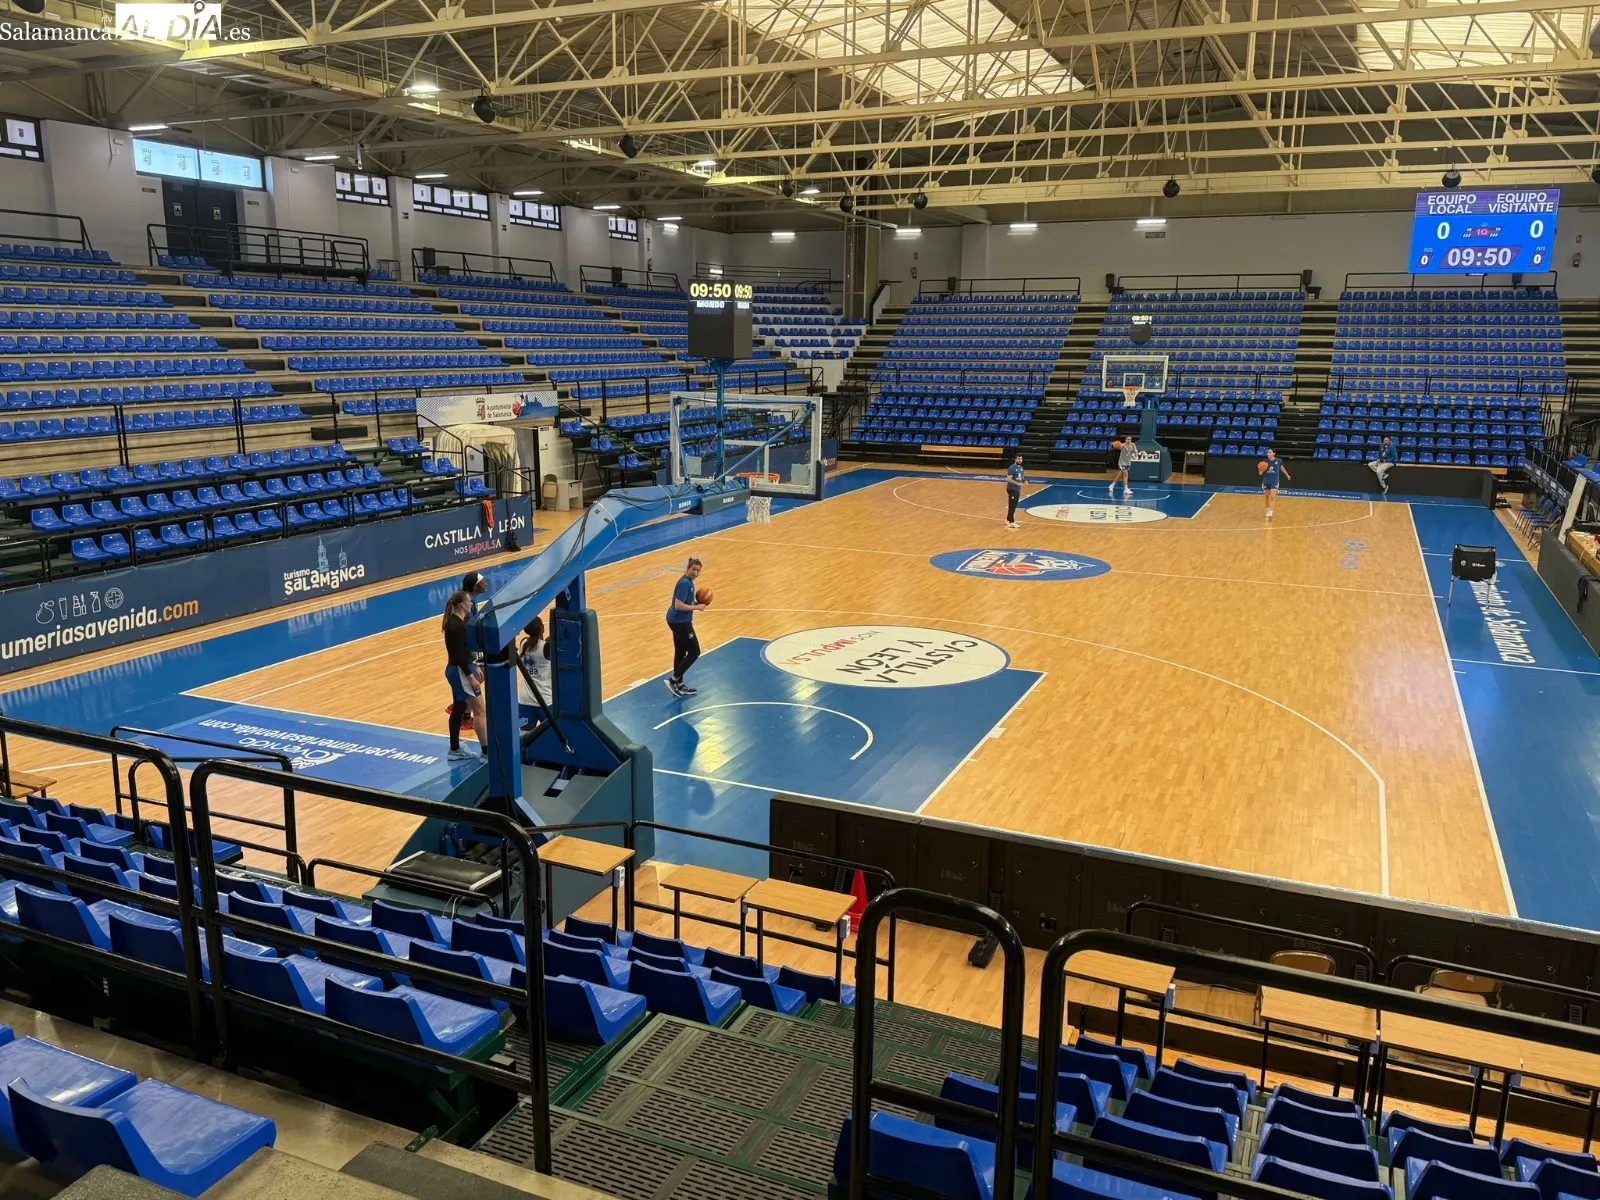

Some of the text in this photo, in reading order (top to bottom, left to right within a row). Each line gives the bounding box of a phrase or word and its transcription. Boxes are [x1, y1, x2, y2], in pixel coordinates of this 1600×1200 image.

[1427, 194, 1477, 205] EQUIPO
[1496, 192, 1547, 203] EQUIPO
[1429, 204, 1473, 215] LOCAL
[1488, 202, 1554, 213] VISITANTE
[1437, 221, 1450, 239] 0
[1477, 228, 1488, 236] 1Q
[1530, 220, 1544, 238] 0
[1420, 255, 1428, 265] 0
[1447, 247, 1512, 266] 09:50
[1533, 253, 1541, 264] 0
[690, 283, 732, 298] 09:50
[424, 525, 482, 549] CASTILLA
[487, 526, 494, 538] Y
[454, 538, 502, 556] NOS IMPULSA
[283, 568, 310, 580] turismo
[852, 629, 882, 641] NOS
[835, 638, 934, 675] Y LEÓN
[864, 639, 979, 685] CASTILLA
